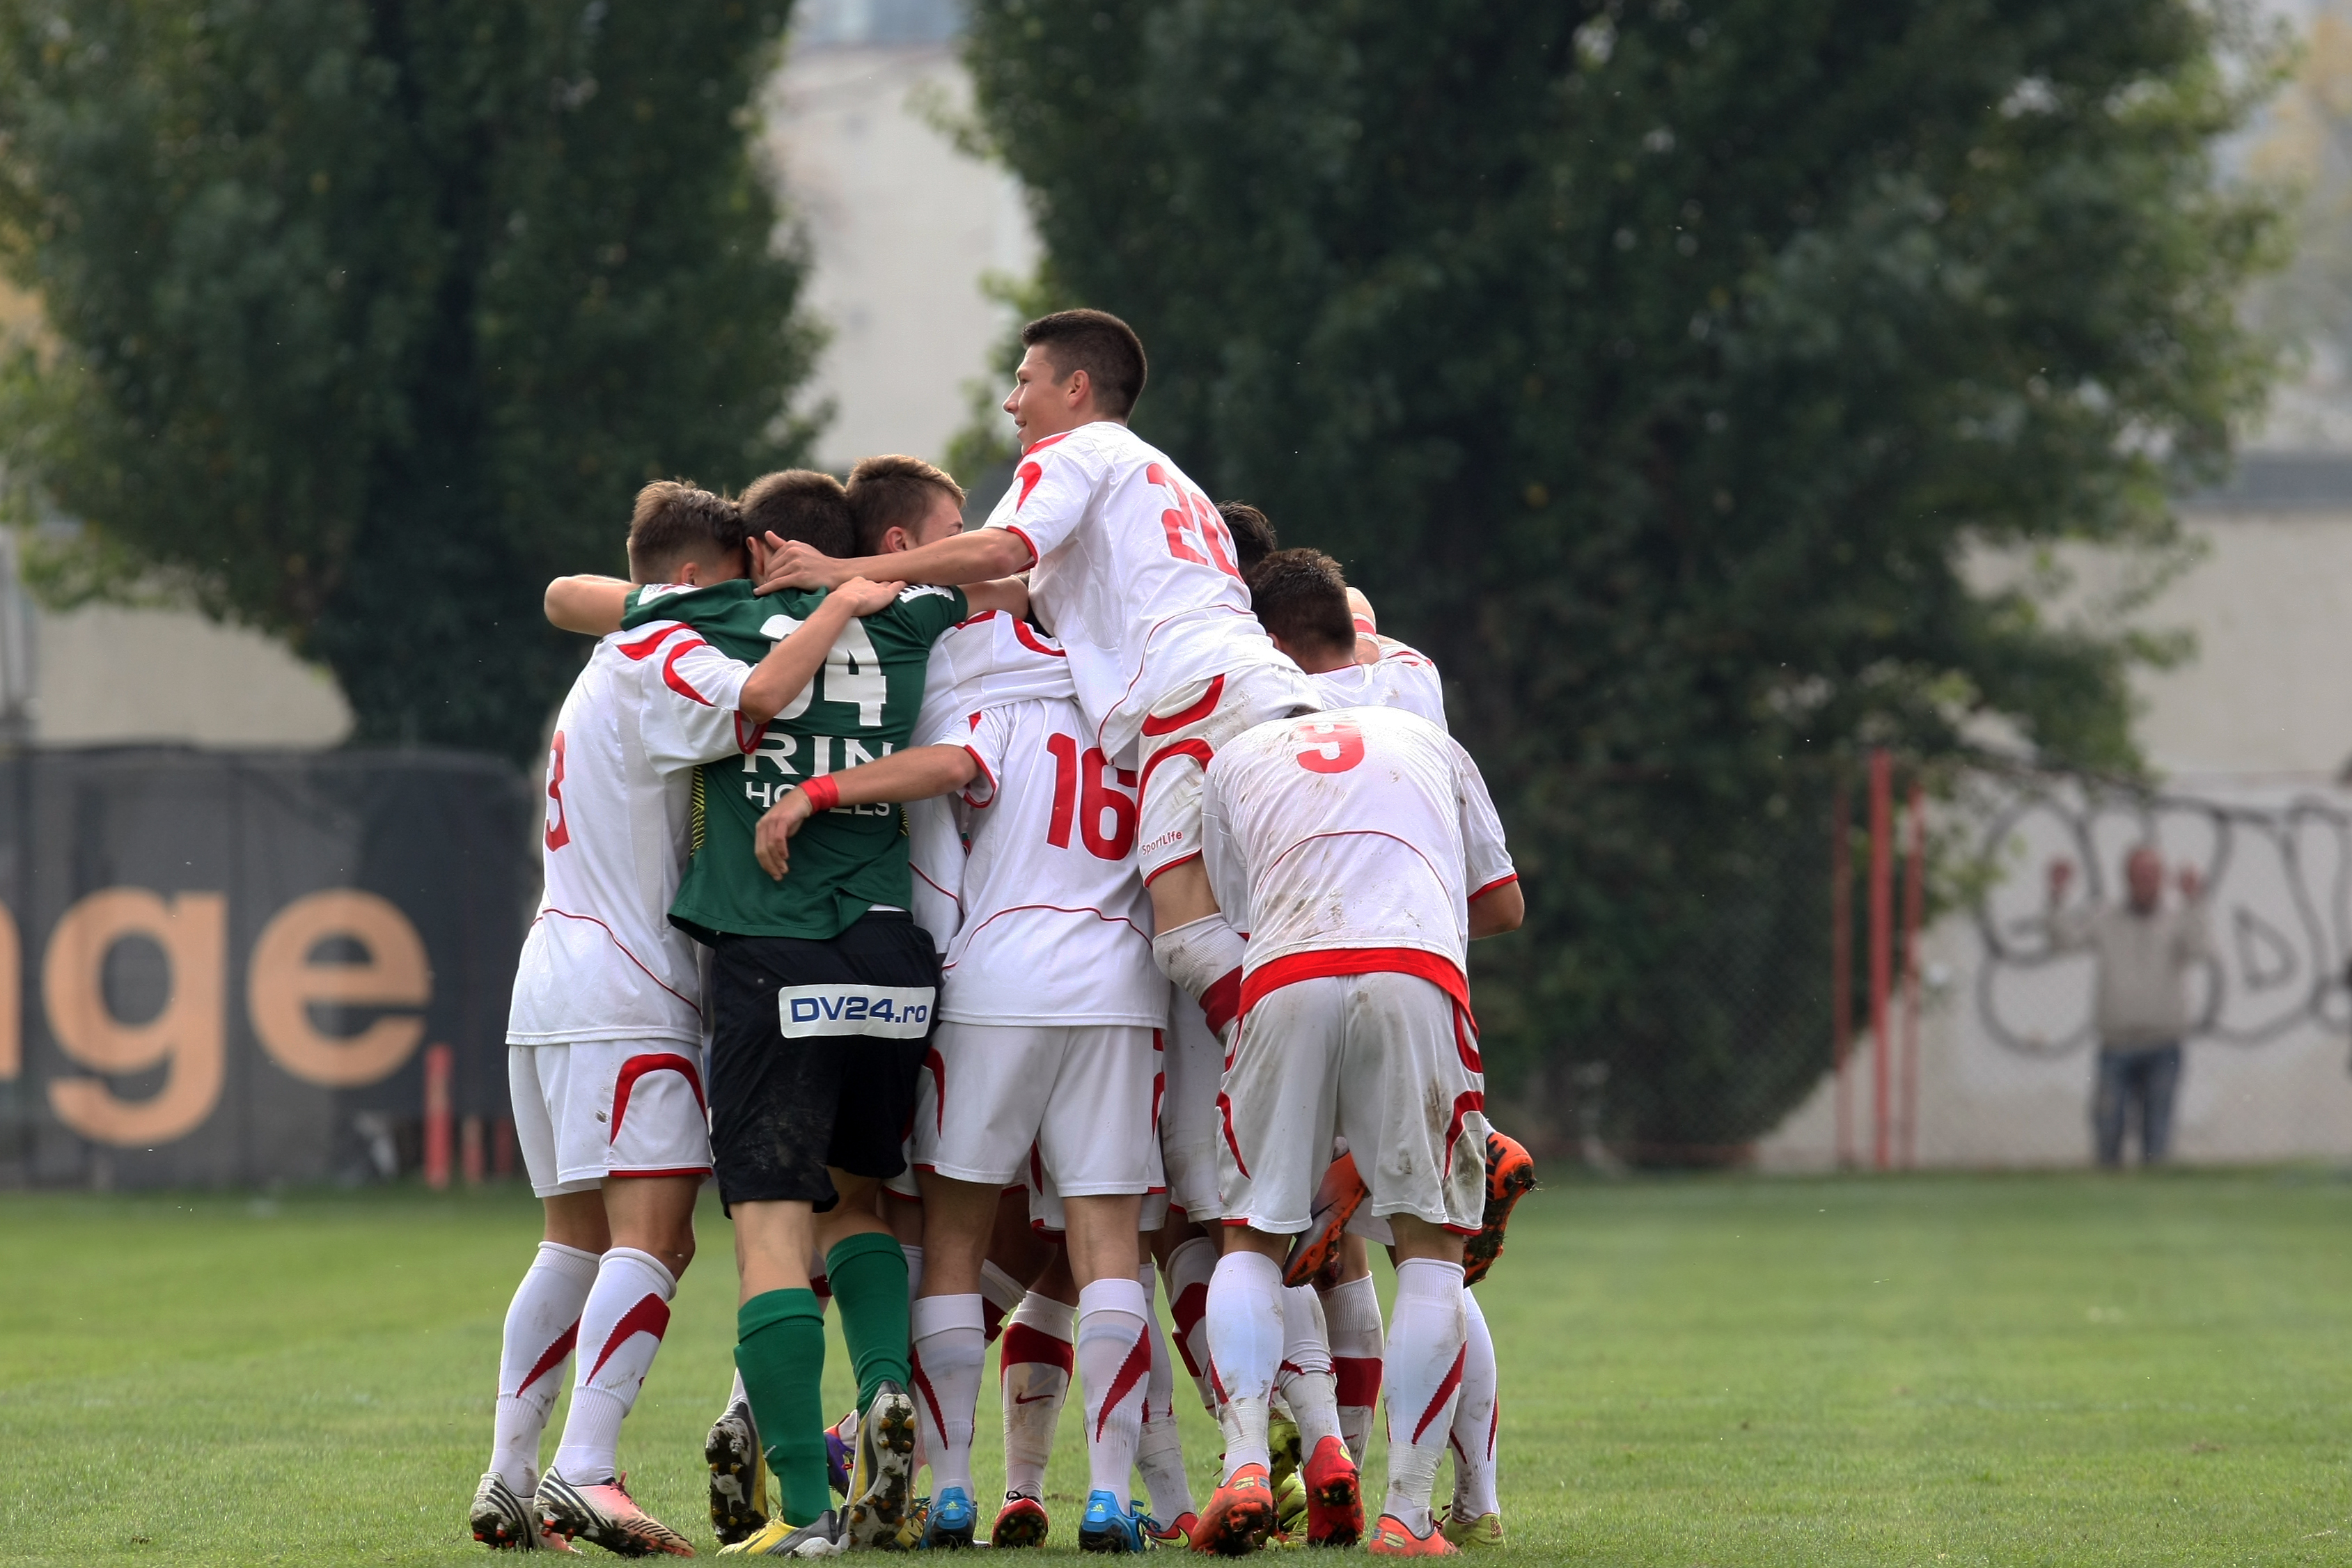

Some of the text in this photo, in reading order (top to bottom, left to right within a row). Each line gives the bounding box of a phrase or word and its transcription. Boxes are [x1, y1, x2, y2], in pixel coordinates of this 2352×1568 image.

[1046, 732, 1138, 861] 16
[1142, 831, 1182, 855] SportLife
[790, 996, 927, 1023] DV24.ro
